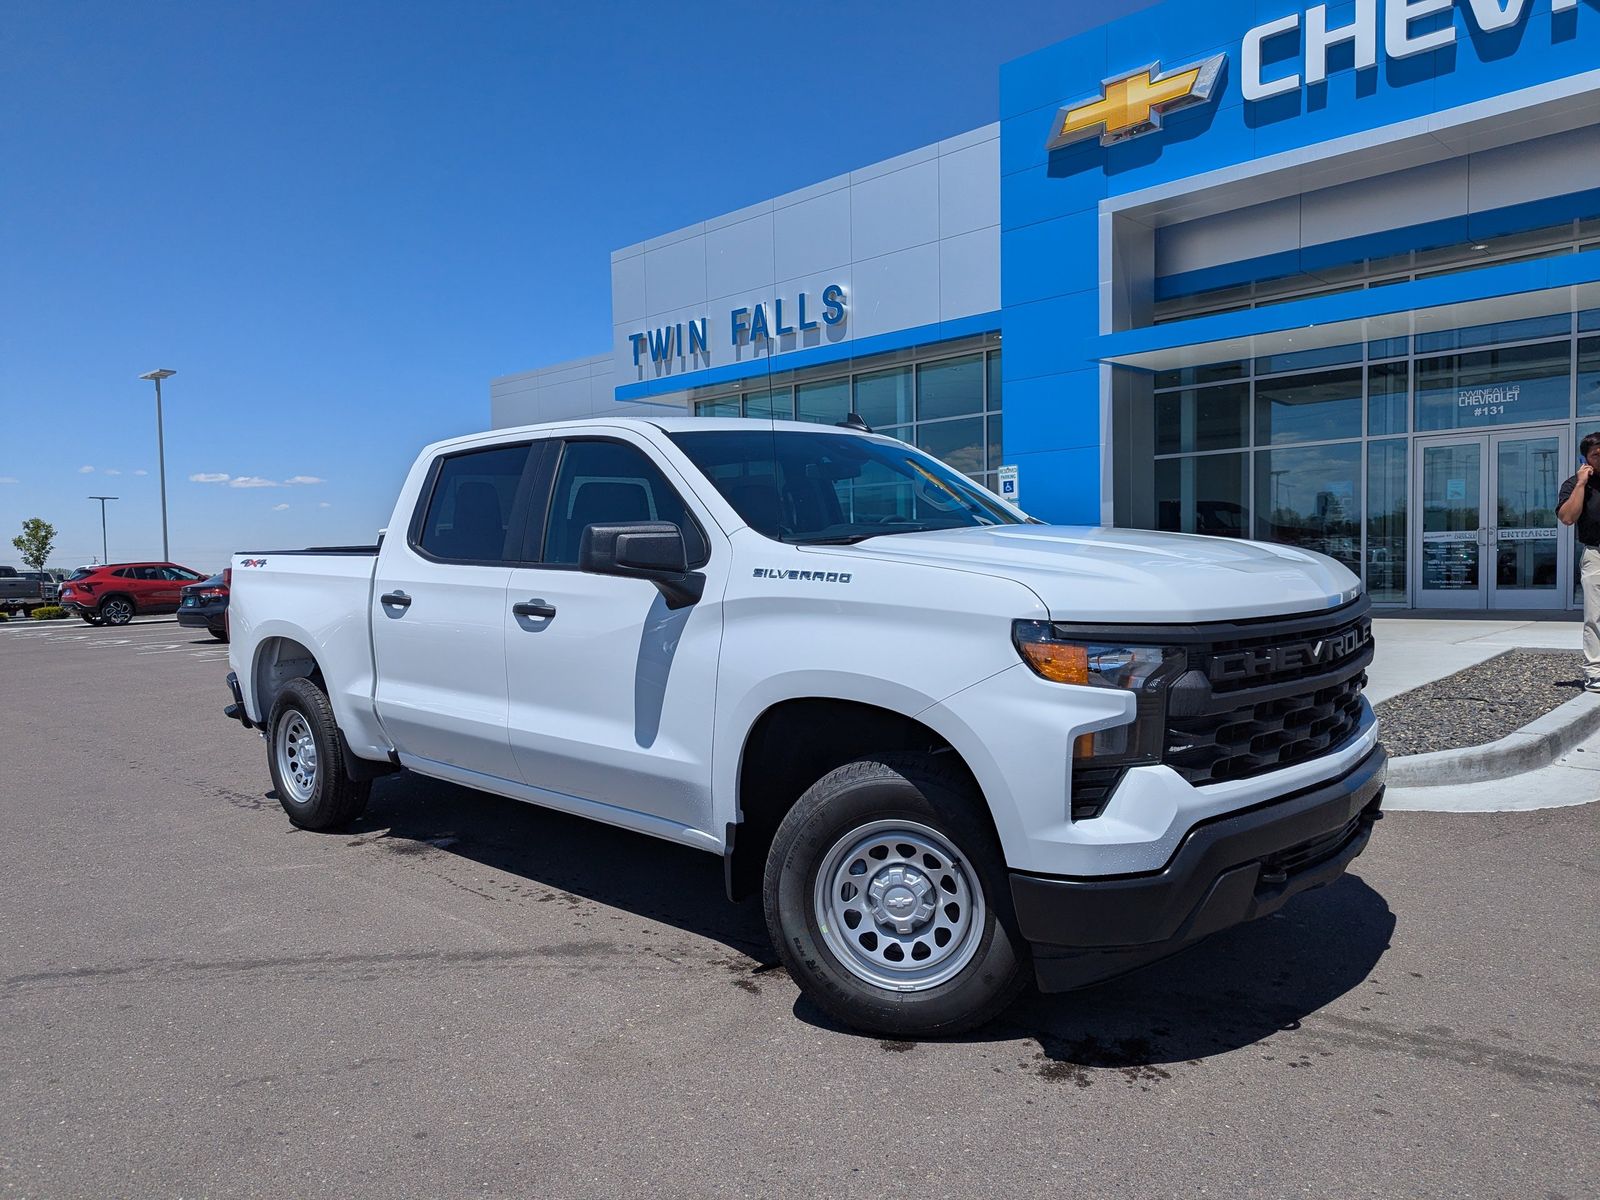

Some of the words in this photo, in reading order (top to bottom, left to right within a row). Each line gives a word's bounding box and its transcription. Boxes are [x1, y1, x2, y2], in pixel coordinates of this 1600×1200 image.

[1241, 0, 1577, 101] CHE
[628, 317, 708, 367] TWIN
[731, 284, 846, 346] FALLS
[1458, 391, 1519, 407] CHEVROLET
[1473, 405, 1504, 417] #131
[1501, 530, 1557, 538] ENTRANCE
[752, 568, 852, 583] SILVERADO
